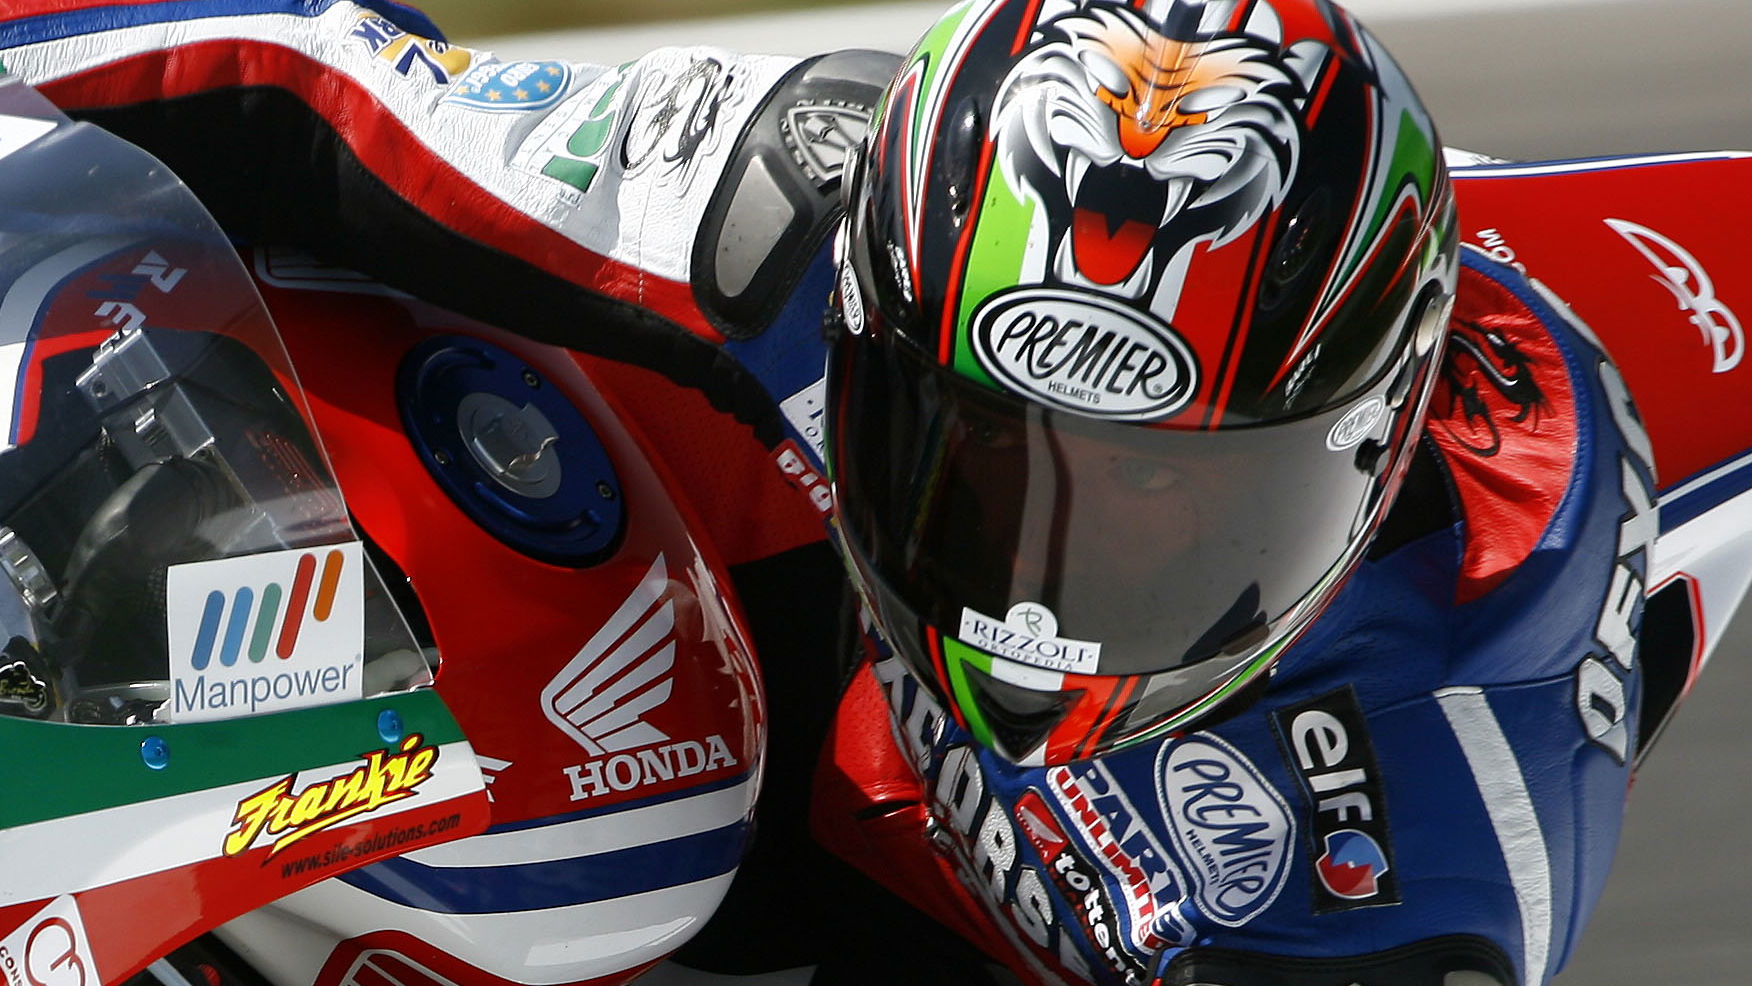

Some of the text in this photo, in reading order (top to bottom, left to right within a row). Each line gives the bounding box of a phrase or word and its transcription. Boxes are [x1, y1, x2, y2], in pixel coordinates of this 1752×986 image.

[996, 310, 1184, 401] PREMIER
[1048, 380, 1101, 405] HELMETS
[174, 660, 354, 714] Manpower
[222, 732, 441, 860] Frankie
[563, 734, 739, 802] HONDA
[1291, 710, 1373, 822] elf
[1173, 758, 1277, 917] PREMIER
